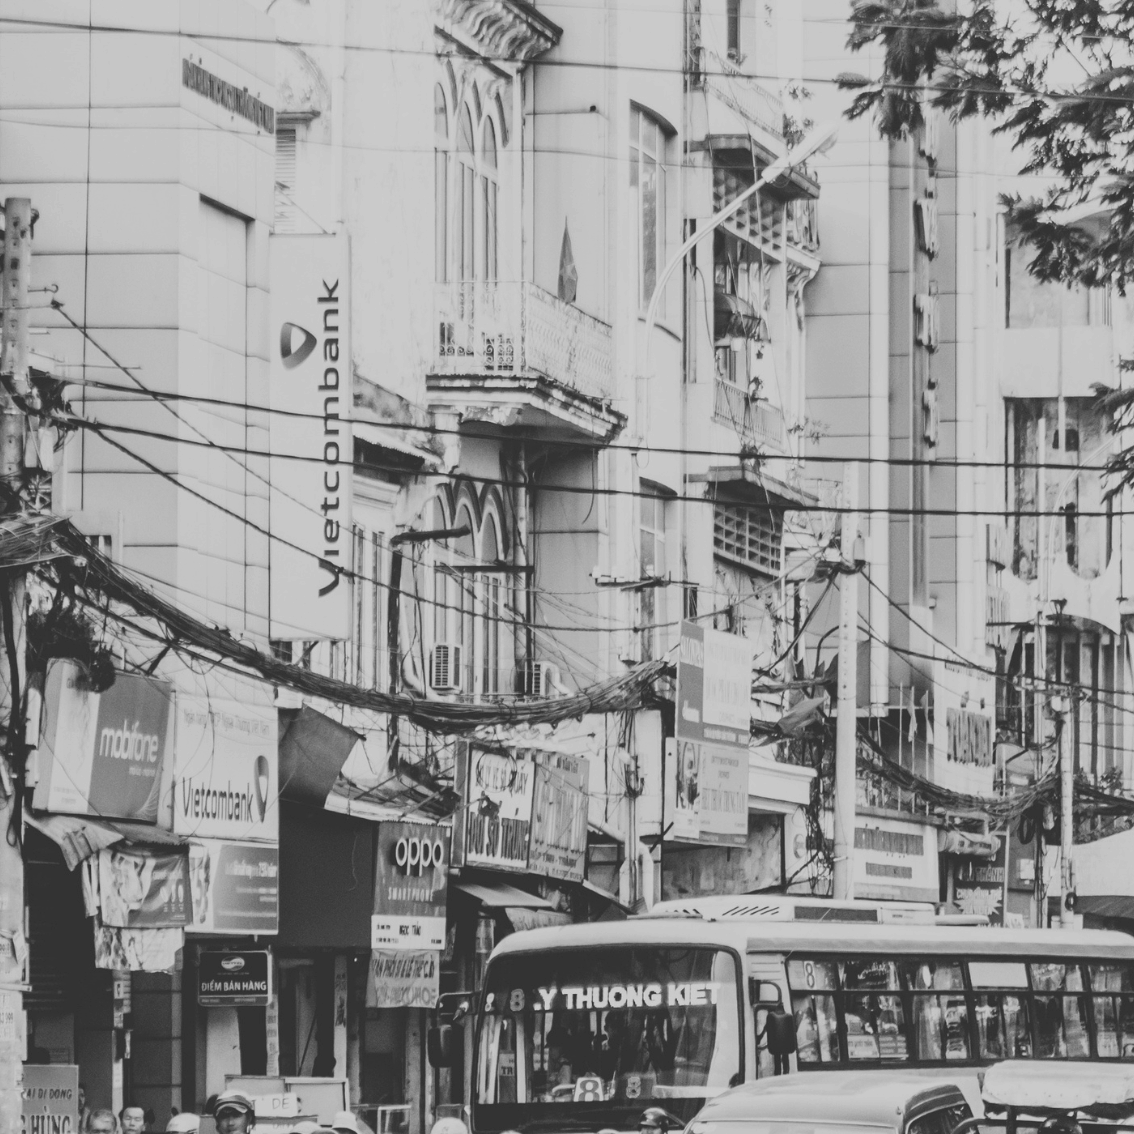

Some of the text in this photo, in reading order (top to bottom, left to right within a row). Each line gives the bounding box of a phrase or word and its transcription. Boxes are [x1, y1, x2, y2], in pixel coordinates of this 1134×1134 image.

[317, 277, 340, 598] Vietcombank
[99, 719, 159, 763] mobifone
[182, 777, 254, 823] Vietcombank
[387, 886, 434, 902] SMARTPHONE
[201, 978, 267, 992] ĐIỂM BÁN HÀNG
[804, 962, 815, 989] 8
[509, 988, 525, 1012] 8
[579, 1076, 641, 1102] 8 8
